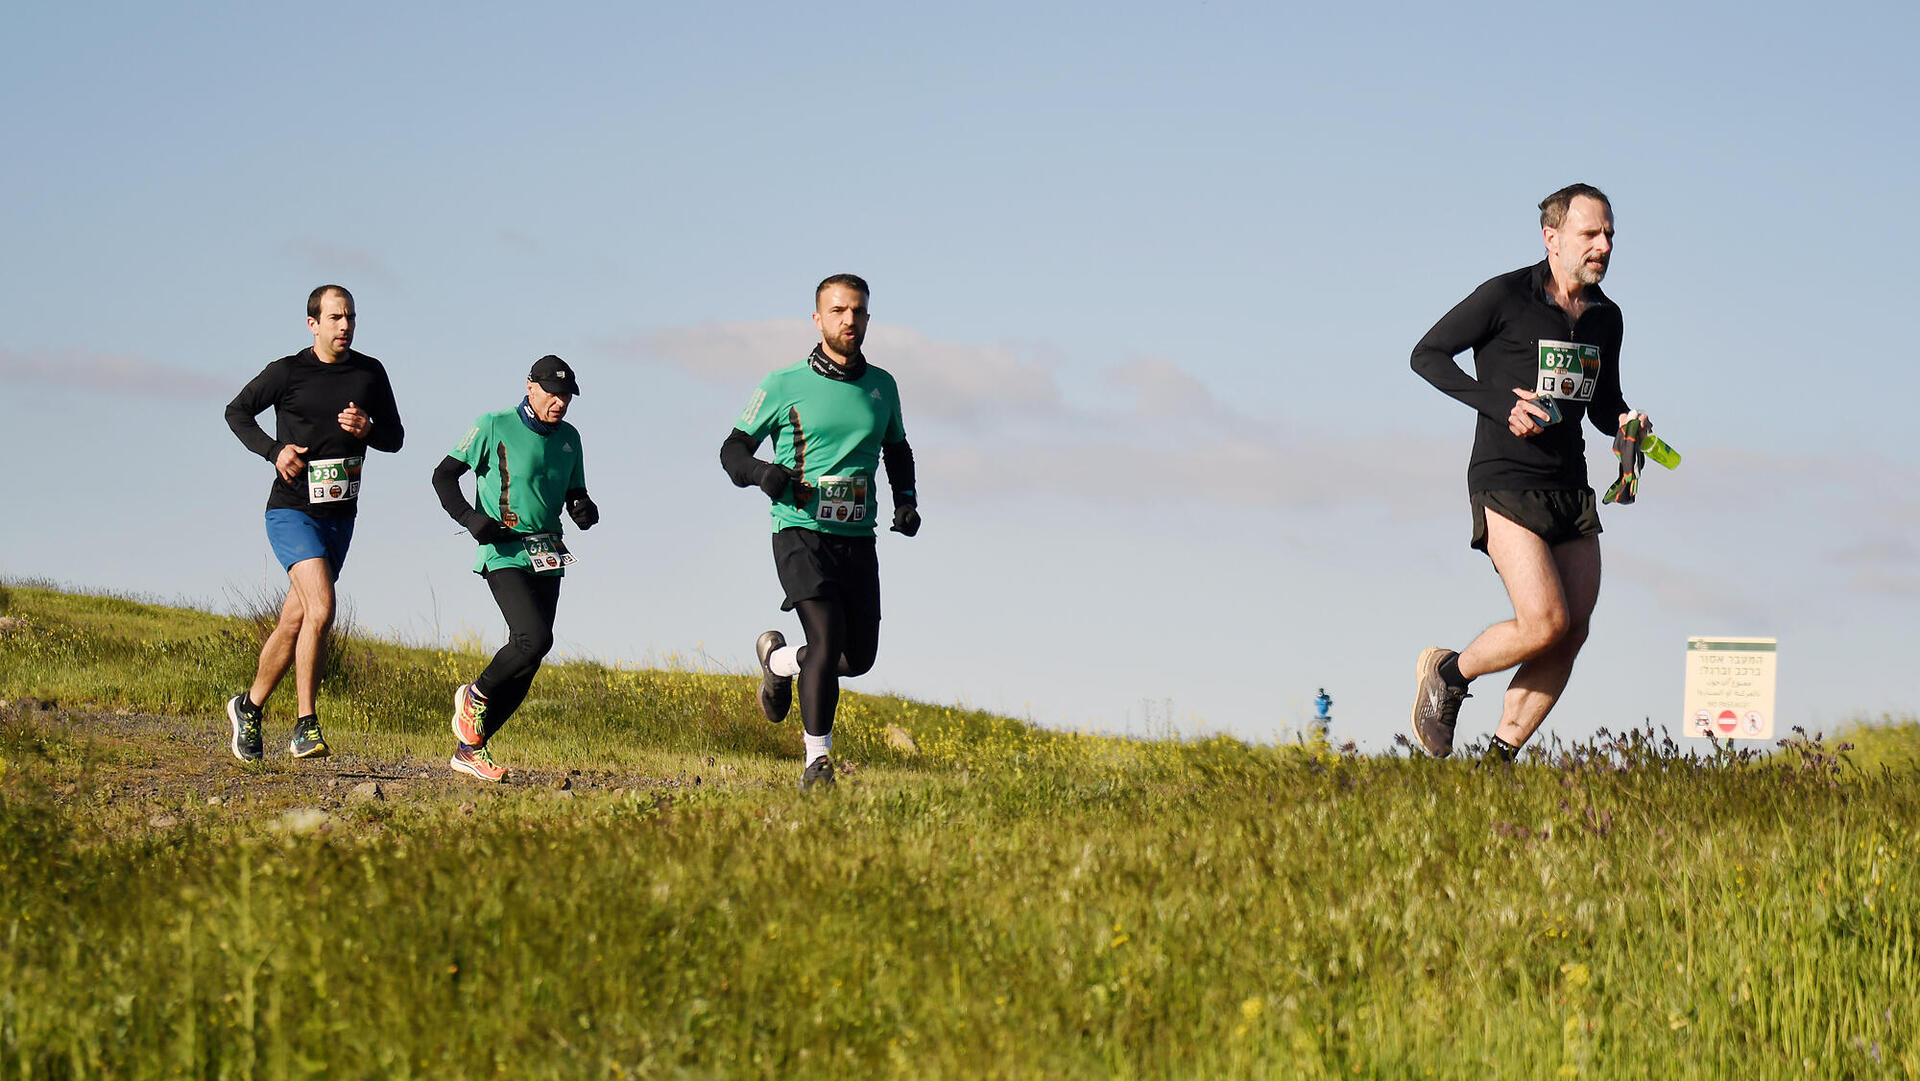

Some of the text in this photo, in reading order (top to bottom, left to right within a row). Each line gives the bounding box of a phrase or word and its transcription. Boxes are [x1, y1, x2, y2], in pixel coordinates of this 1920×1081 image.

[1545, 352, 1573, 368] 827
[314, 468, 338, 480] 930
[825, 486, 848, 498] 647
[1698, 655, 1724, 664] אסור
